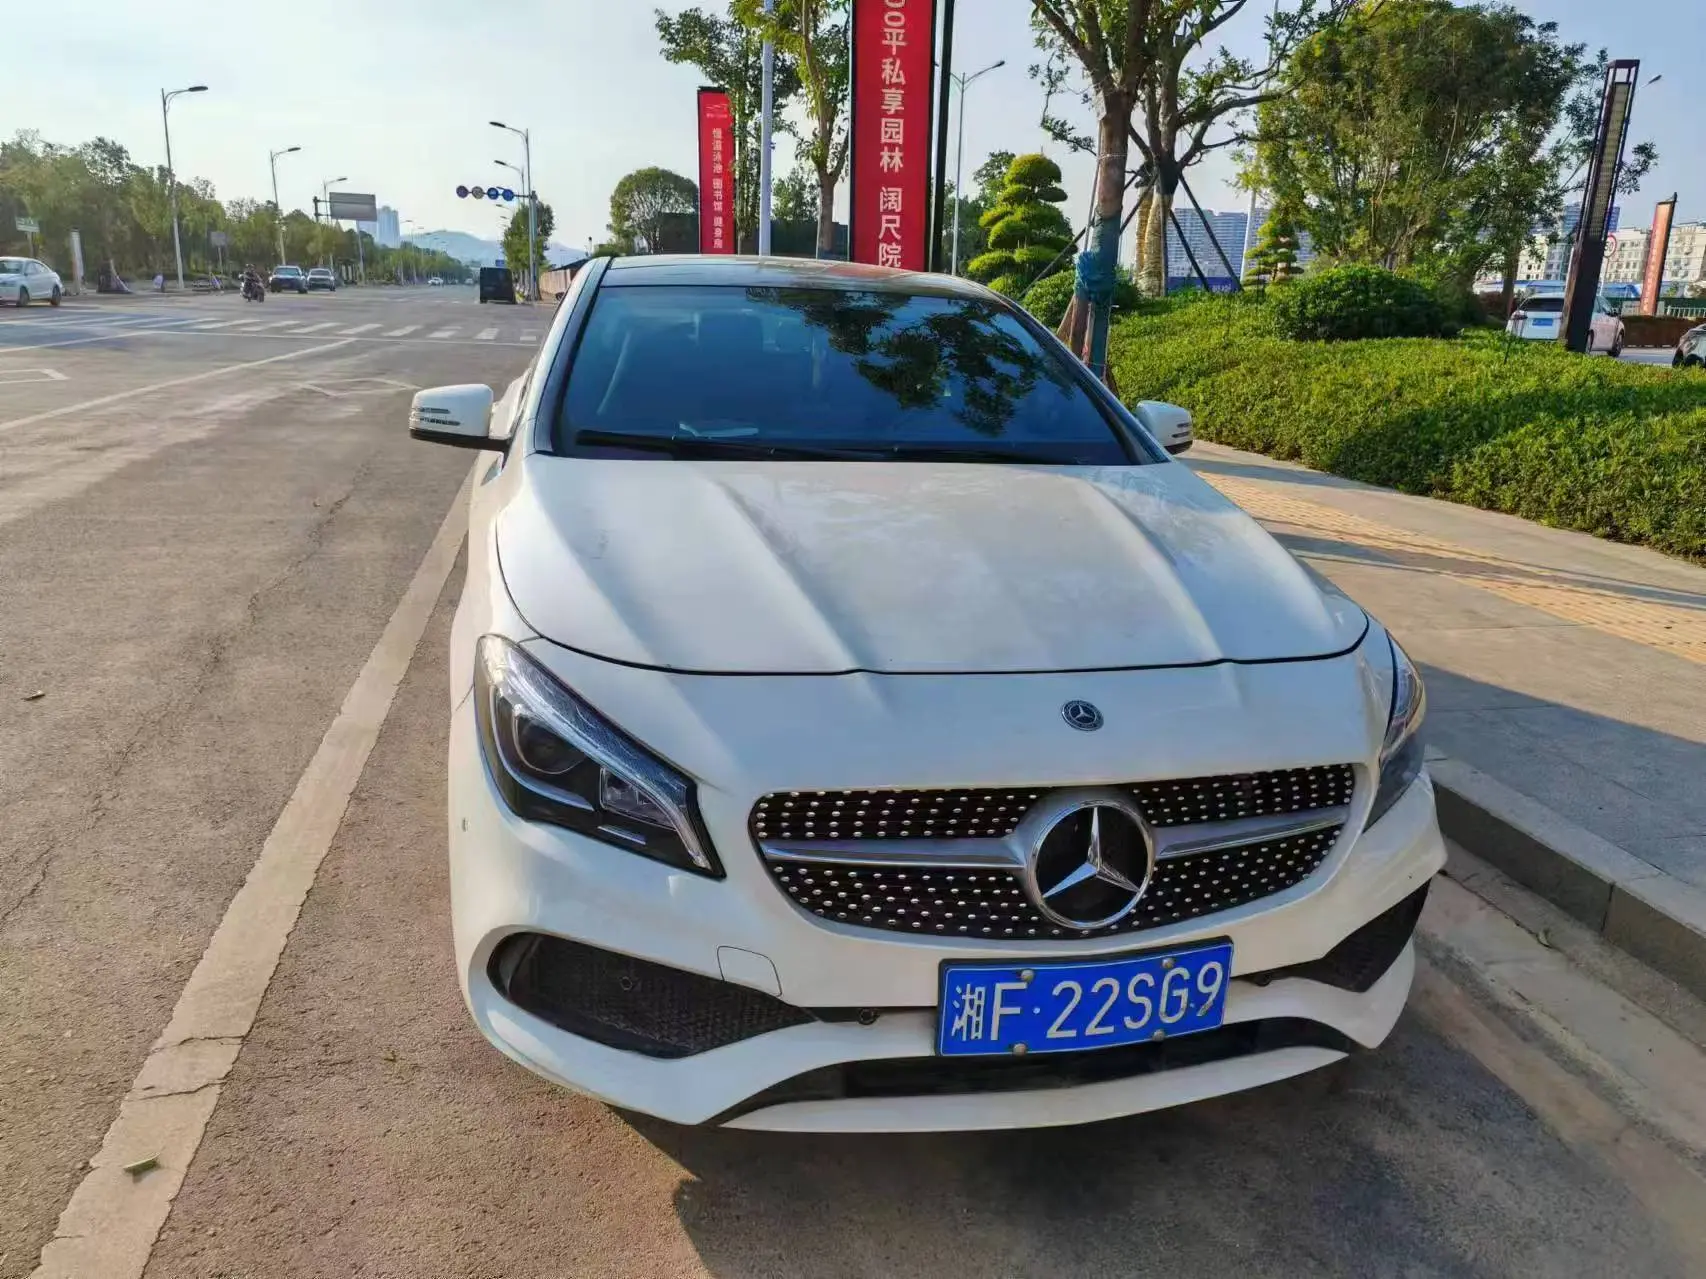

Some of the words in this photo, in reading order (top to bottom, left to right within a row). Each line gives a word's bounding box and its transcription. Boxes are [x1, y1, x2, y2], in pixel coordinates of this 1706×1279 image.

[712, 178, 723, 212] 图书馆
[878, 186, 903, 268] 阔尺院
